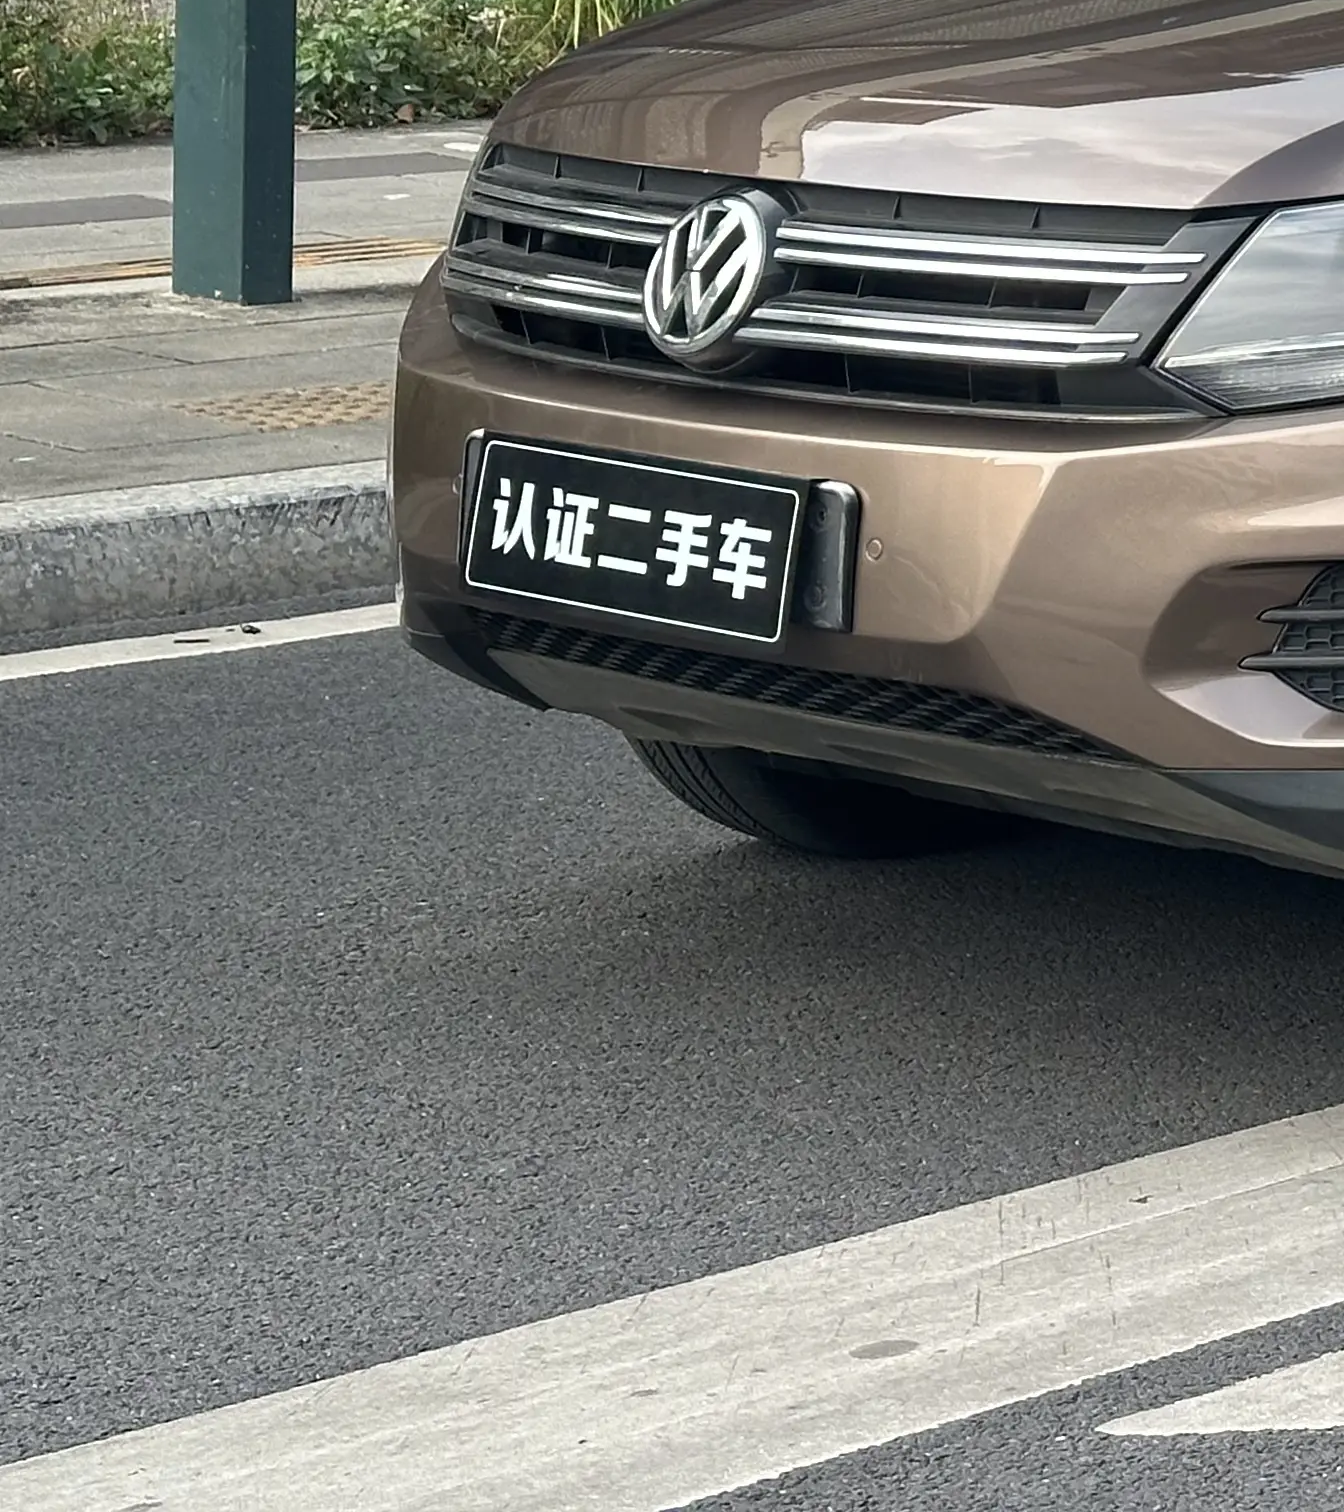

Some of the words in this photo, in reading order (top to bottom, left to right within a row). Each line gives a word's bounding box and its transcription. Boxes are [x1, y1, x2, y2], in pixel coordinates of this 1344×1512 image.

[650, 196, 760, 350] VW
[490, 477, 773, 600] 认证二手车
